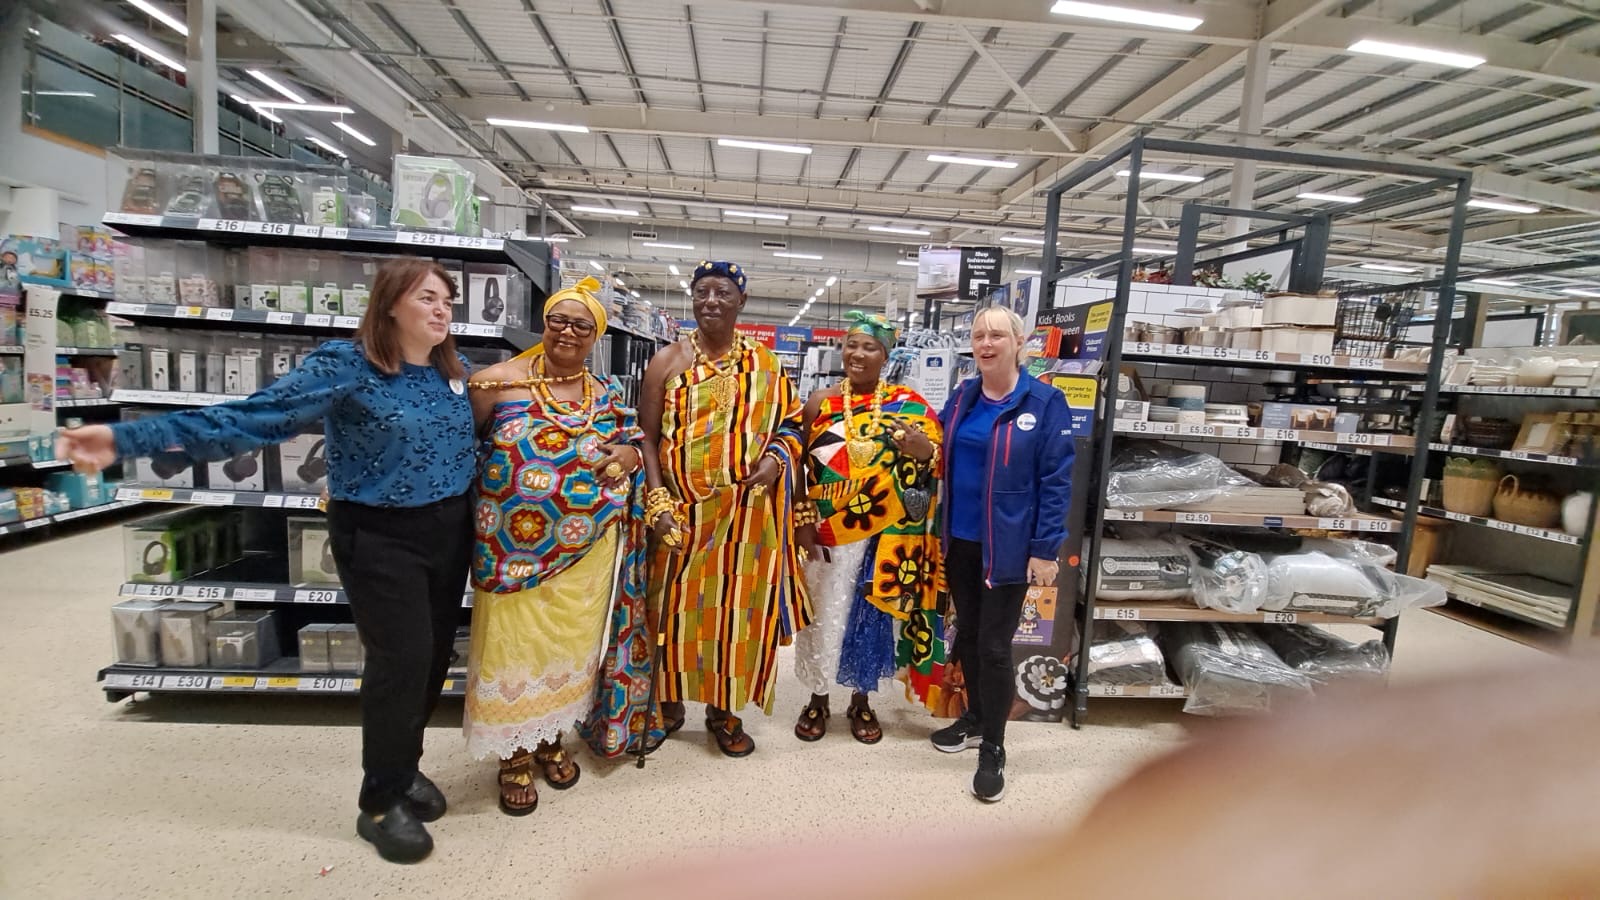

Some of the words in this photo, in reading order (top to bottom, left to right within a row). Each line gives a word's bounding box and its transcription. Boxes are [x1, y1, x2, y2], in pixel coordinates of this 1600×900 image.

[215, 220, 238, 231] £16
[261, 223, 284, 234] £16
[411, 233, 436, 244] £25
[458, 237, 482, 247] £25
[29, 308, 53, 318] £5.25
[1038, 314, 1055, 325] Kids'
[1055, 312, 1075, 324] Books
[452, 324, 468, 333] 32
[1136, 343, 1151, 353] £3
[1175, 345, 1190, 355] £4
[1213, 347, 1227, 358] £5
[1255, 350, 1269, 361] £6
[1312, 354, 1331, 365] £10
[1359, 358, 1374, 367] £15
[1073, 391, 1091, 399] prices
[1133, 421, 1147, 431] £5
[1164, 424, 1174, 432] £3
[1190, 425, 1214, 434] £5.50
[1237, 427, 1250, 437] £5
[1277, 429, 1294, 439] £16
[1348, 434, 1367, 444] £20
[1123, 511, 1136, 520] £3
[1185, 513, 1210, 522] £2.50
[1333, 519, 1345, 529] £6
[1370, 521, 1388, 531] £10
[1496, 521, 1510, 530] £12
[1526, 527, 1539, 536] £12
[150, 586, 173, 596] £10
[197, 588, 219, 598] £15
[308, 591, 333, 602] £20
[1117, 608, 1135, 619] £15
[1274, 612, 1294, 623] £20
[131, 676, 154, 687] £14
[177, 677, 203, 688] £30
[313, 678, 336, 689] £10
[1104, 684, 1117, 695] £5
